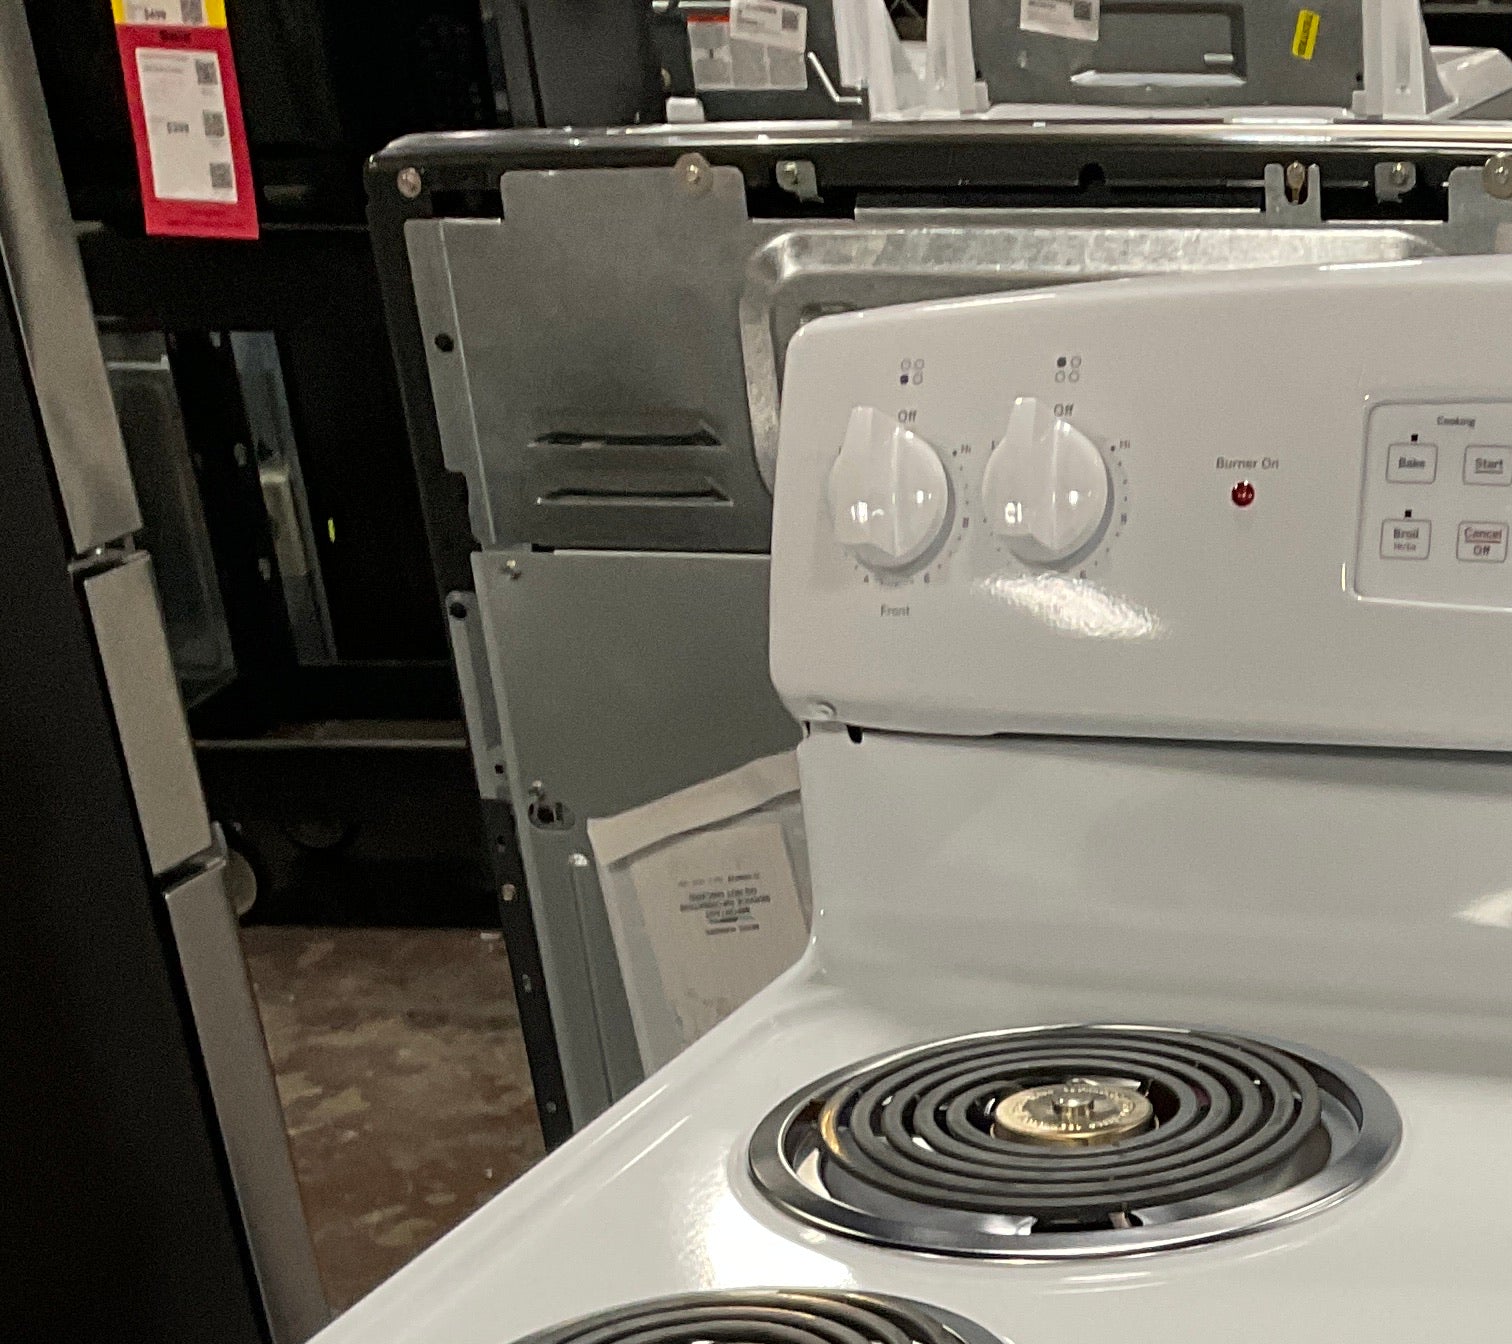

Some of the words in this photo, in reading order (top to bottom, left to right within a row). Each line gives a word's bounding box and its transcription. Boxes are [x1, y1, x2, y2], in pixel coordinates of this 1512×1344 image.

[897, 409, 918, 423] Off
[1053, 403, 1075, 417] Off
[1436, 415, 1476, 428] Cooking
[1215, 456, 1258, 469] Burner
[1261, 456, 1280, 470] On
[1398, 456, 1427, 469] Bake
[1474, 457, 1504, 470] Start
[1393, 527, 1419, 539] Broil
[1463, 526, 1503, 540] Cancel
[1473, 544, 1491, 557] Off
